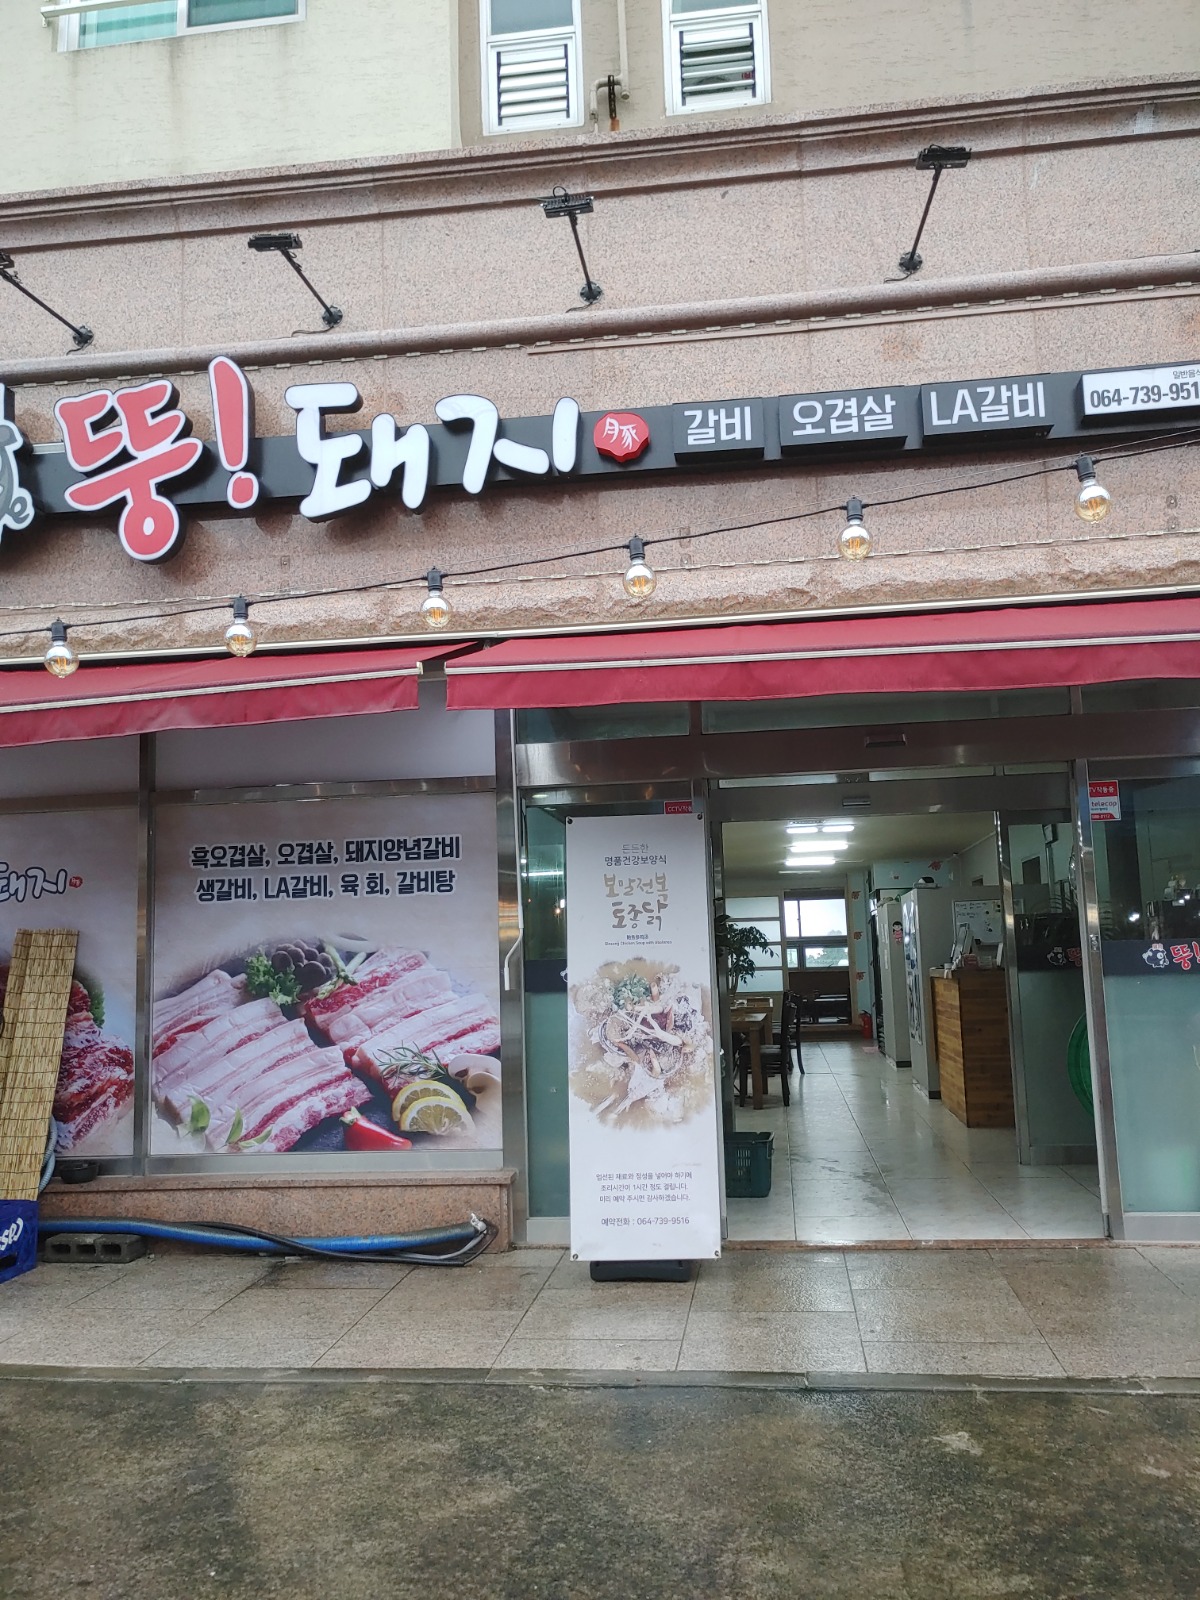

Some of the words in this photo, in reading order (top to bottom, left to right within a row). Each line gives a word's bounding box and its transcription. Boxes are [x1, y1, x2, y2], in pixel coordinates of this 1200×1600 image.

[930, 381, 1047, 427] LA갈비
[1090, 381, 1200, 408] 064-739-951
[683, 405, 753, 446] 갈비
[792, 393, 895, 438] 오겹살
[284, 382, 580, 521] 돼지
[1091, 800, 1117, 808] telecop
[191, 842, 271, 870] 흑오겹살,
[277, 839, 340, 867] 오겹살,
[345, 835, 461, 865] 돼지양념갈비
[604, 855, 667, 867] 명품건강보양식
[622, 844, 649, 853] 든든한
[196, 877, 258, 903] 생갈비,
[264, 874, 333, 901] LA갈비,
[396, 869, 457, 895] 갈비탕
[612, 900, 668, 931] 토종닭
[596, 1173, 614, 1181] 엄선된
[636, 1172, 653, 1180] 정성을
[655, 1172, 672, 1180] 넣어야
[674, 1171, 692, 1179] 하기에
[650, 1183, 661, 1191] 정도
[663, 1182, 688, 1191] 걸립니다.
[600, 1195, 611, 1203] 미리
[647, 1194, 690, 1202] 감사하겠습니다.
[601, 1217, 630, 1226] 예약전화
[636, 1216, 690, 1225] 064-739-9516
